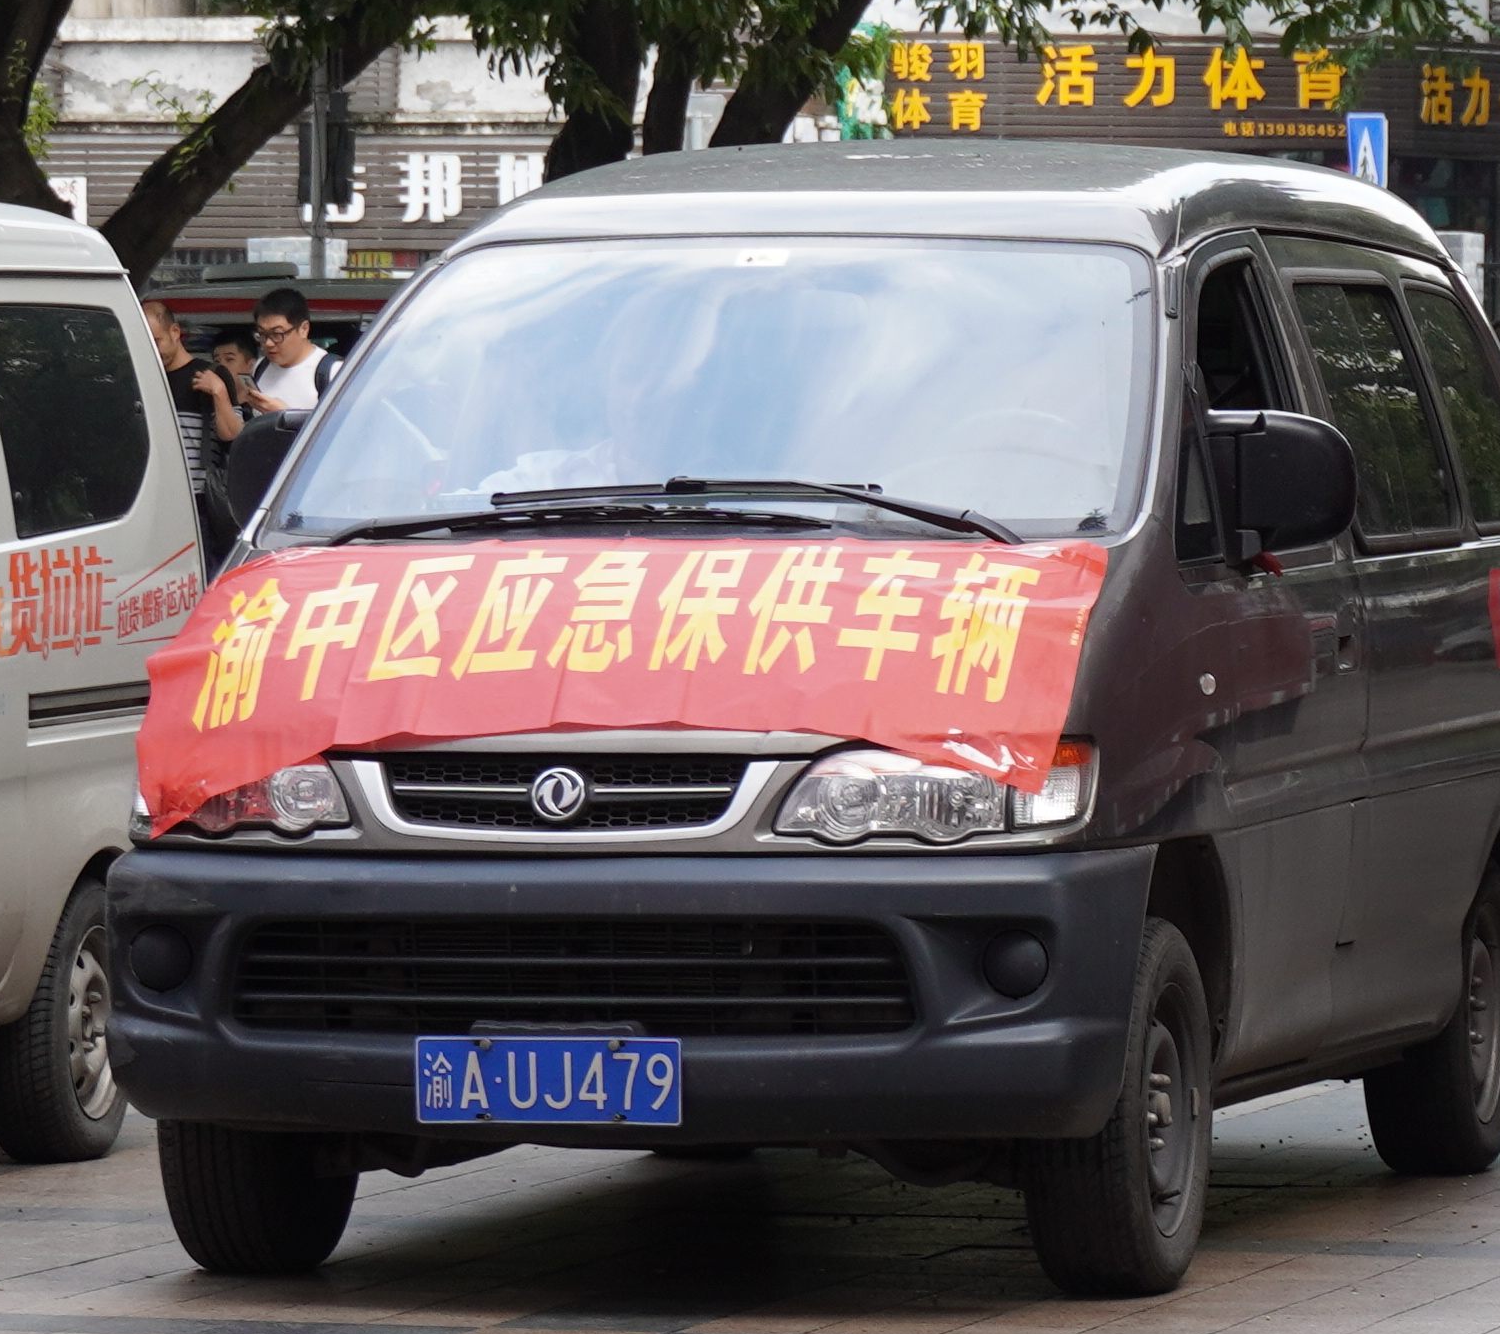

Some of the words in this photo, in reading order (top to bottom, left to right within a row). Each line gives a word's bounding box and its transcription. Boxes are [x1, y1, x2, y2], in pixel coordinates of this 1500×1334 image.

[893, 42, 985, 83] 骏羽
[1036, 45, 1348, 110] 活力体育
[893, 89, 988, 131] 体育
[8, 546, 104, 655] 货拉拉
[191, 547, 1040, 731] 渝中区应急保供车辆
